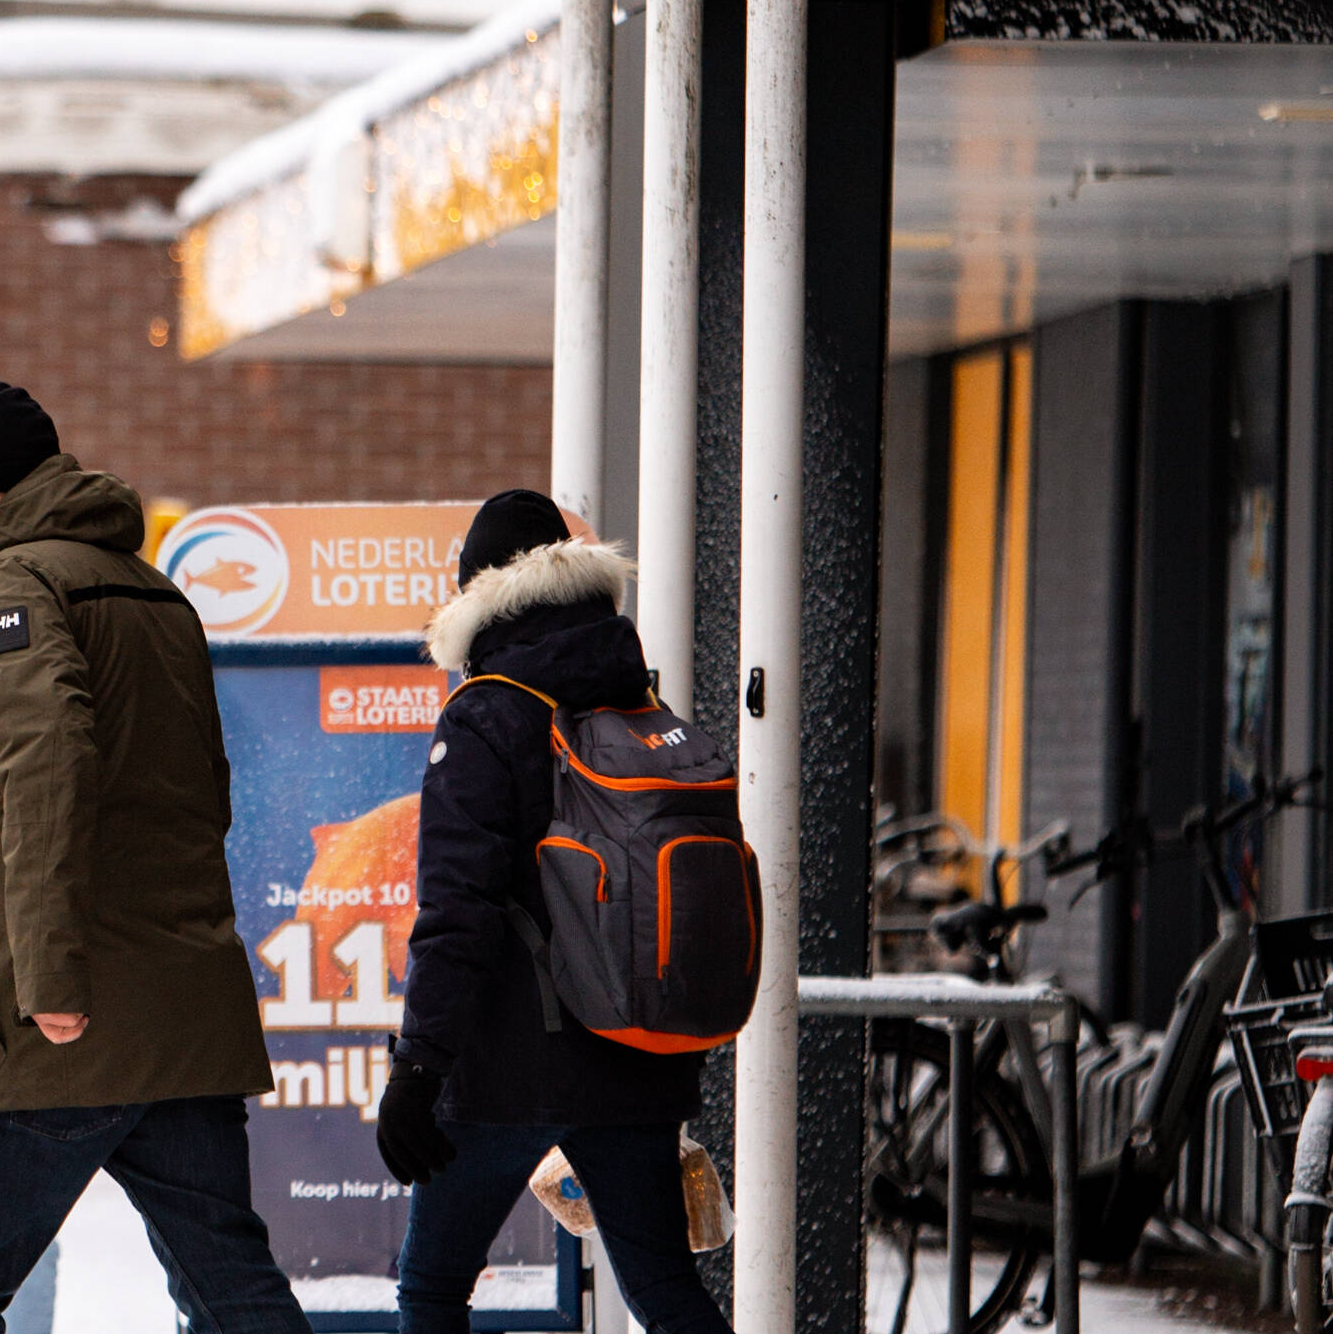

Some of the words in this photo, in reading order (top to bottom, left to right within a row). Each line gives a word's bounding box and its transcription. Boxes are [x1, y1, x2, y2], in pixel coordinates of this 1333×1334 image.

[356, 685, 440, 707] STAATS
[266, 882, 373, 911] Jackpot
[379, 883, 411, 906] 10
[258, 921, 406, 1029] 11
[261, 1047, 389, 1121] milj
[289, 1180, 340, 1202] Koop
[342, 1179, 380, 1198] hier
[380, 1180, 399, 1201] je
